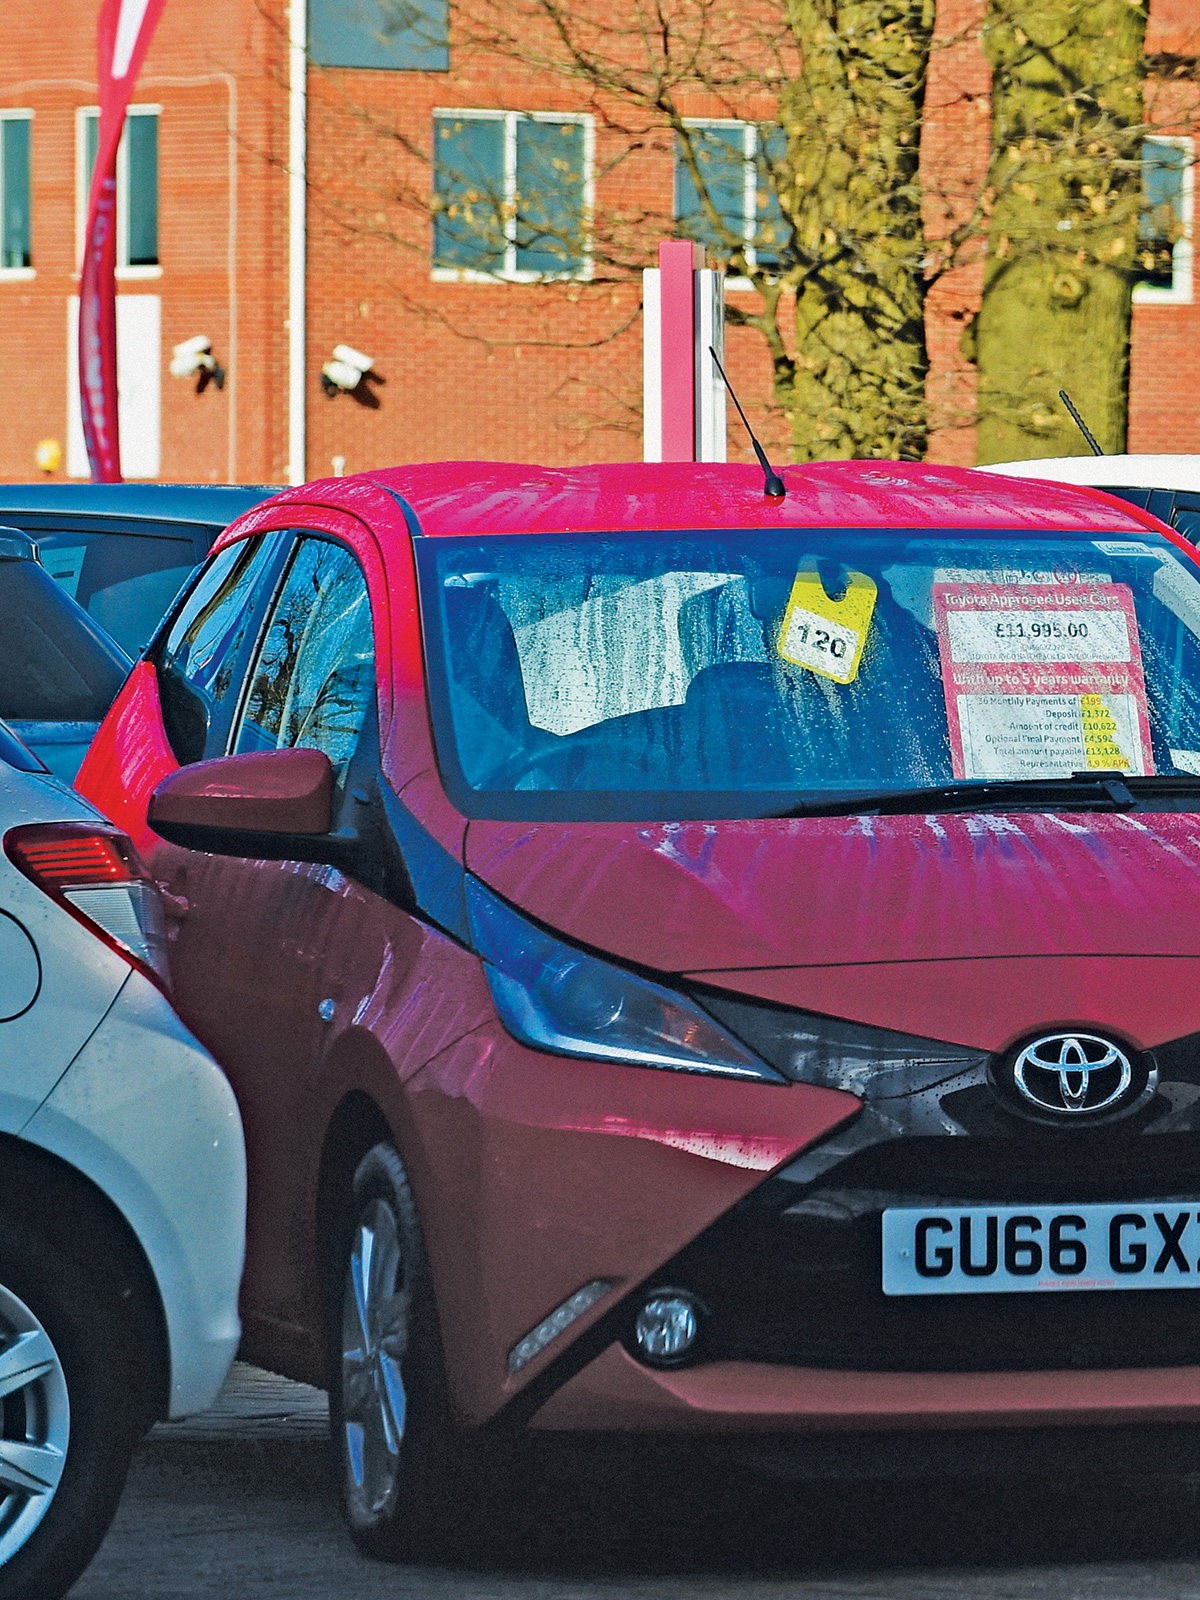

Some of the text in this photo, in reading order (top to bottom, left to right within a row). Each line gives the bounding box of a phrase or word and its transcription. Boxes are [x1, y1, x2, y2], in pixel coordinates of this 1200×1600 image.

[944, 593, 1119, 608] Toyota Approved Used Cars
[797, 624, 847, 659] 120
[953, 674, 1129, 687] With up to 5 years warranty
[990, 697, 1024, 707] Monthly
[1026, 696, 1067, 706] Payments
[1068, 696, 1077, 705] of
[1081, 697, 1101, 706] £199
[1045, 709, 1110, 719] Deposit £1,372
[1009, 722, 1117, 732] Amount of credit £10,622
[985, 734, 1021, 745] Optional
[1023, 734, 1043, 744] Final
[1044, 734, 1081, 745] Payment
[993, 746, 1120, 757] Total amount payable £13,128
[1020, 759, 1083, 769] Representative
[914, 1214, 1088, 1278] GU66
